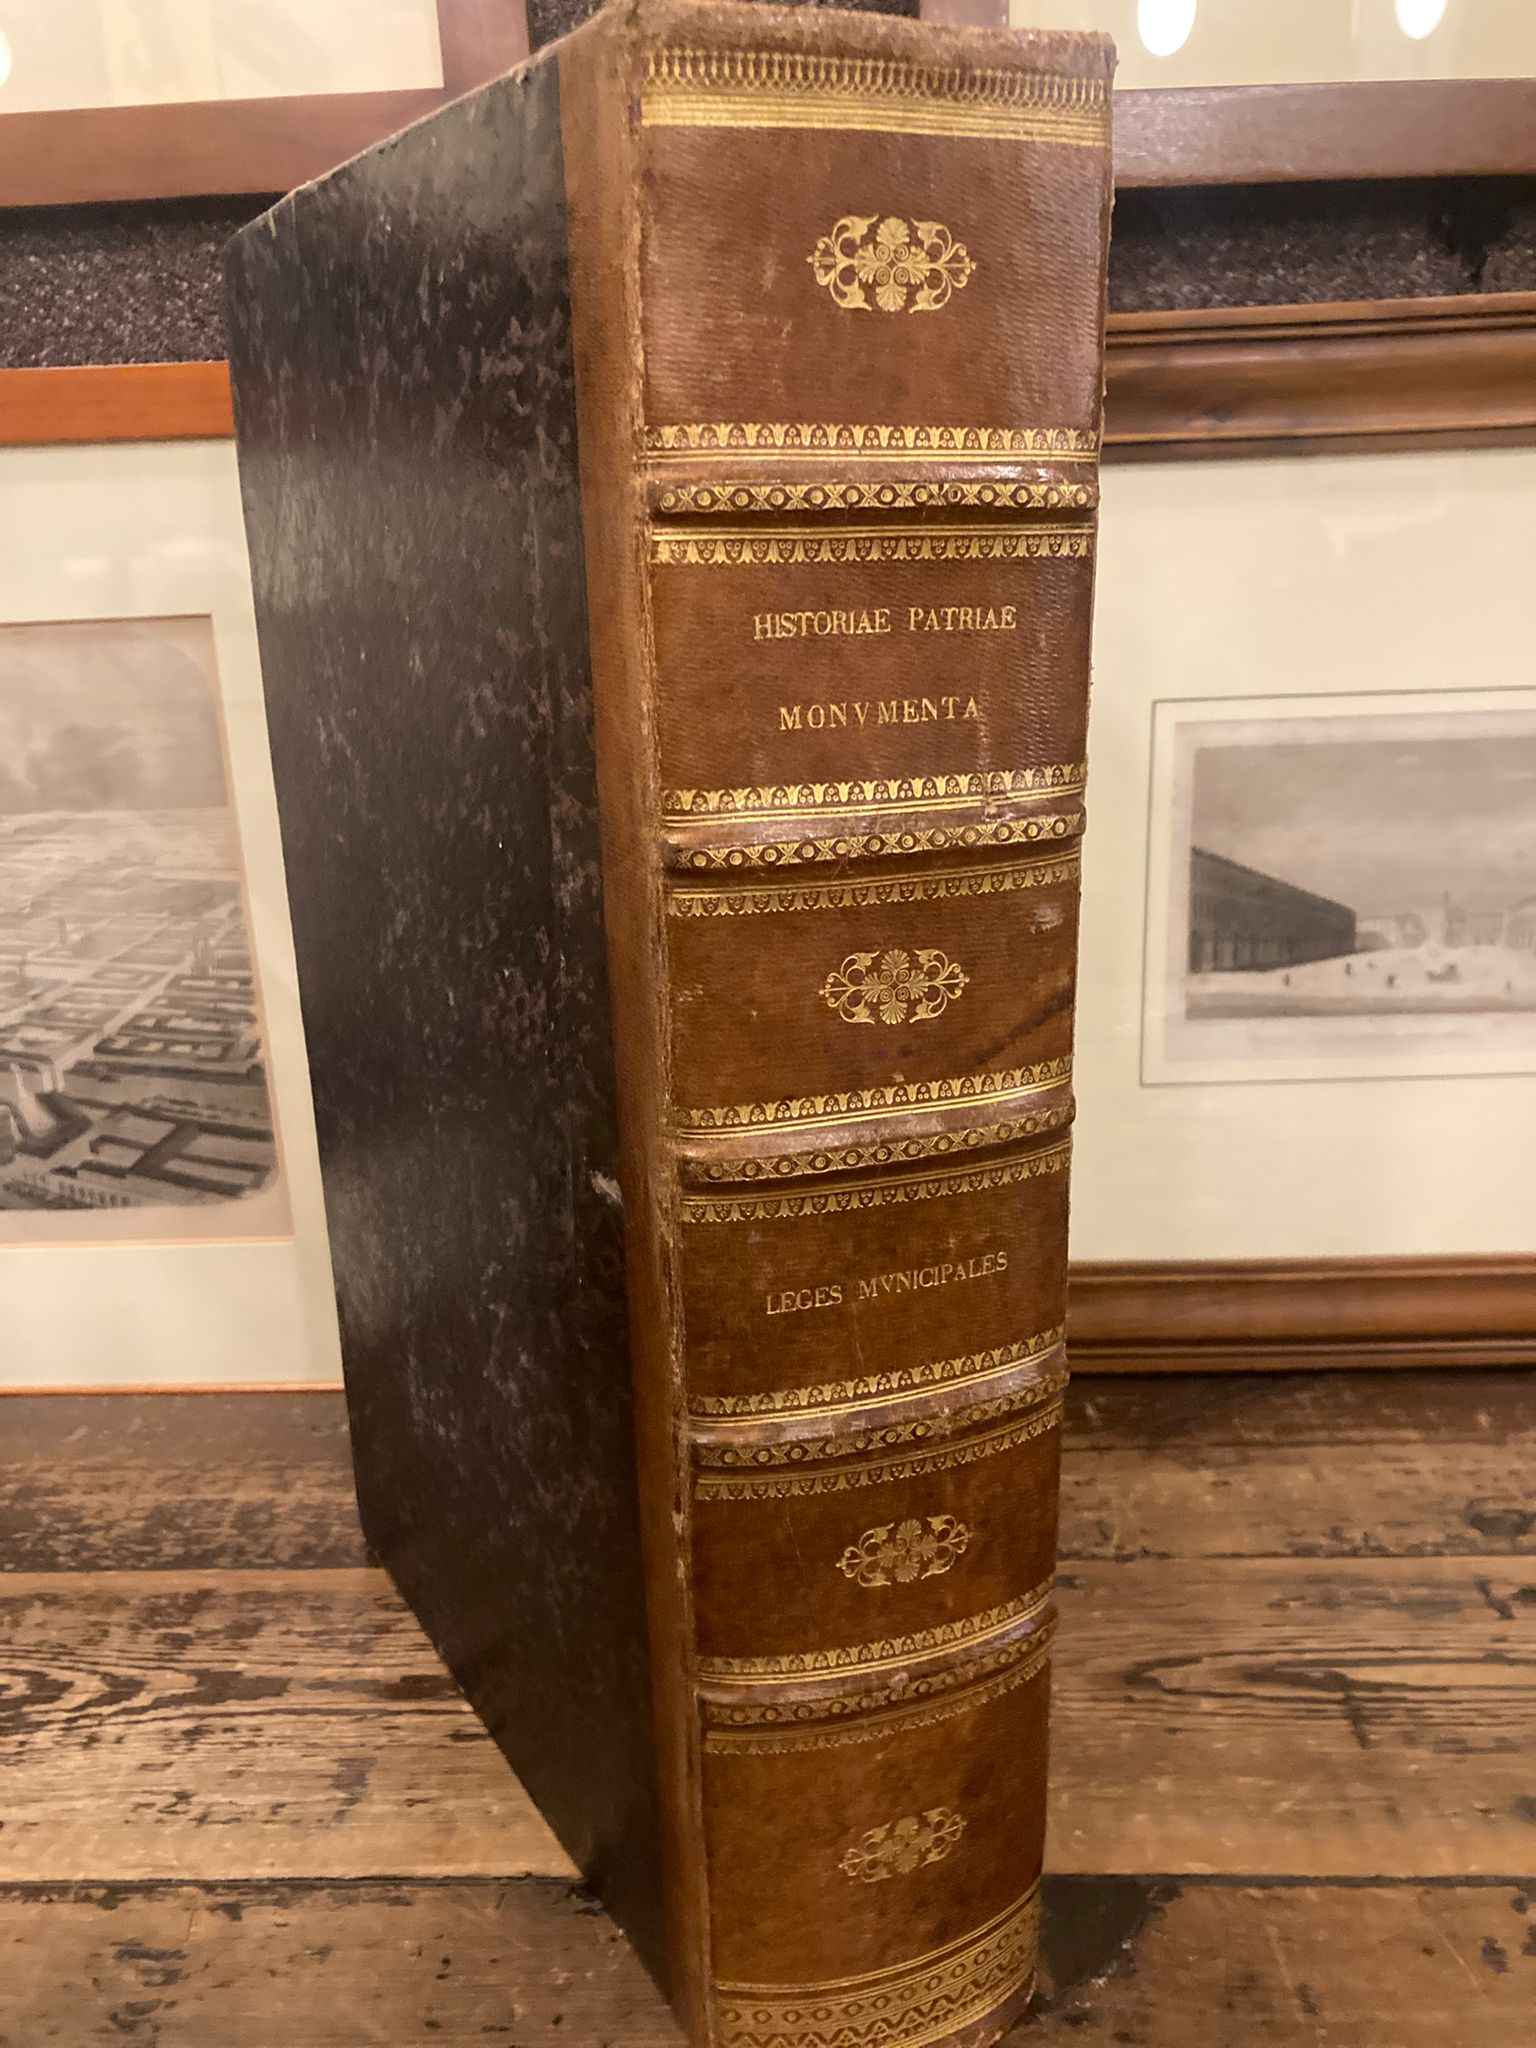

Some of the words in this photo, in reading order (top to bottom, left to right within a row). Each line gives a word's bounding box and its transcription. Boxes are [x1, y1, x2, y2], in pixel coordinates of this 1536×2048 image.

[753, 608, 892, 640] HISTORIAE
[908, 605, 1017, 631] PATRIAE
[766, 1284, 843, 1315] LEGES
[858, 1251, 1008, 1300] MVNICIPALES
